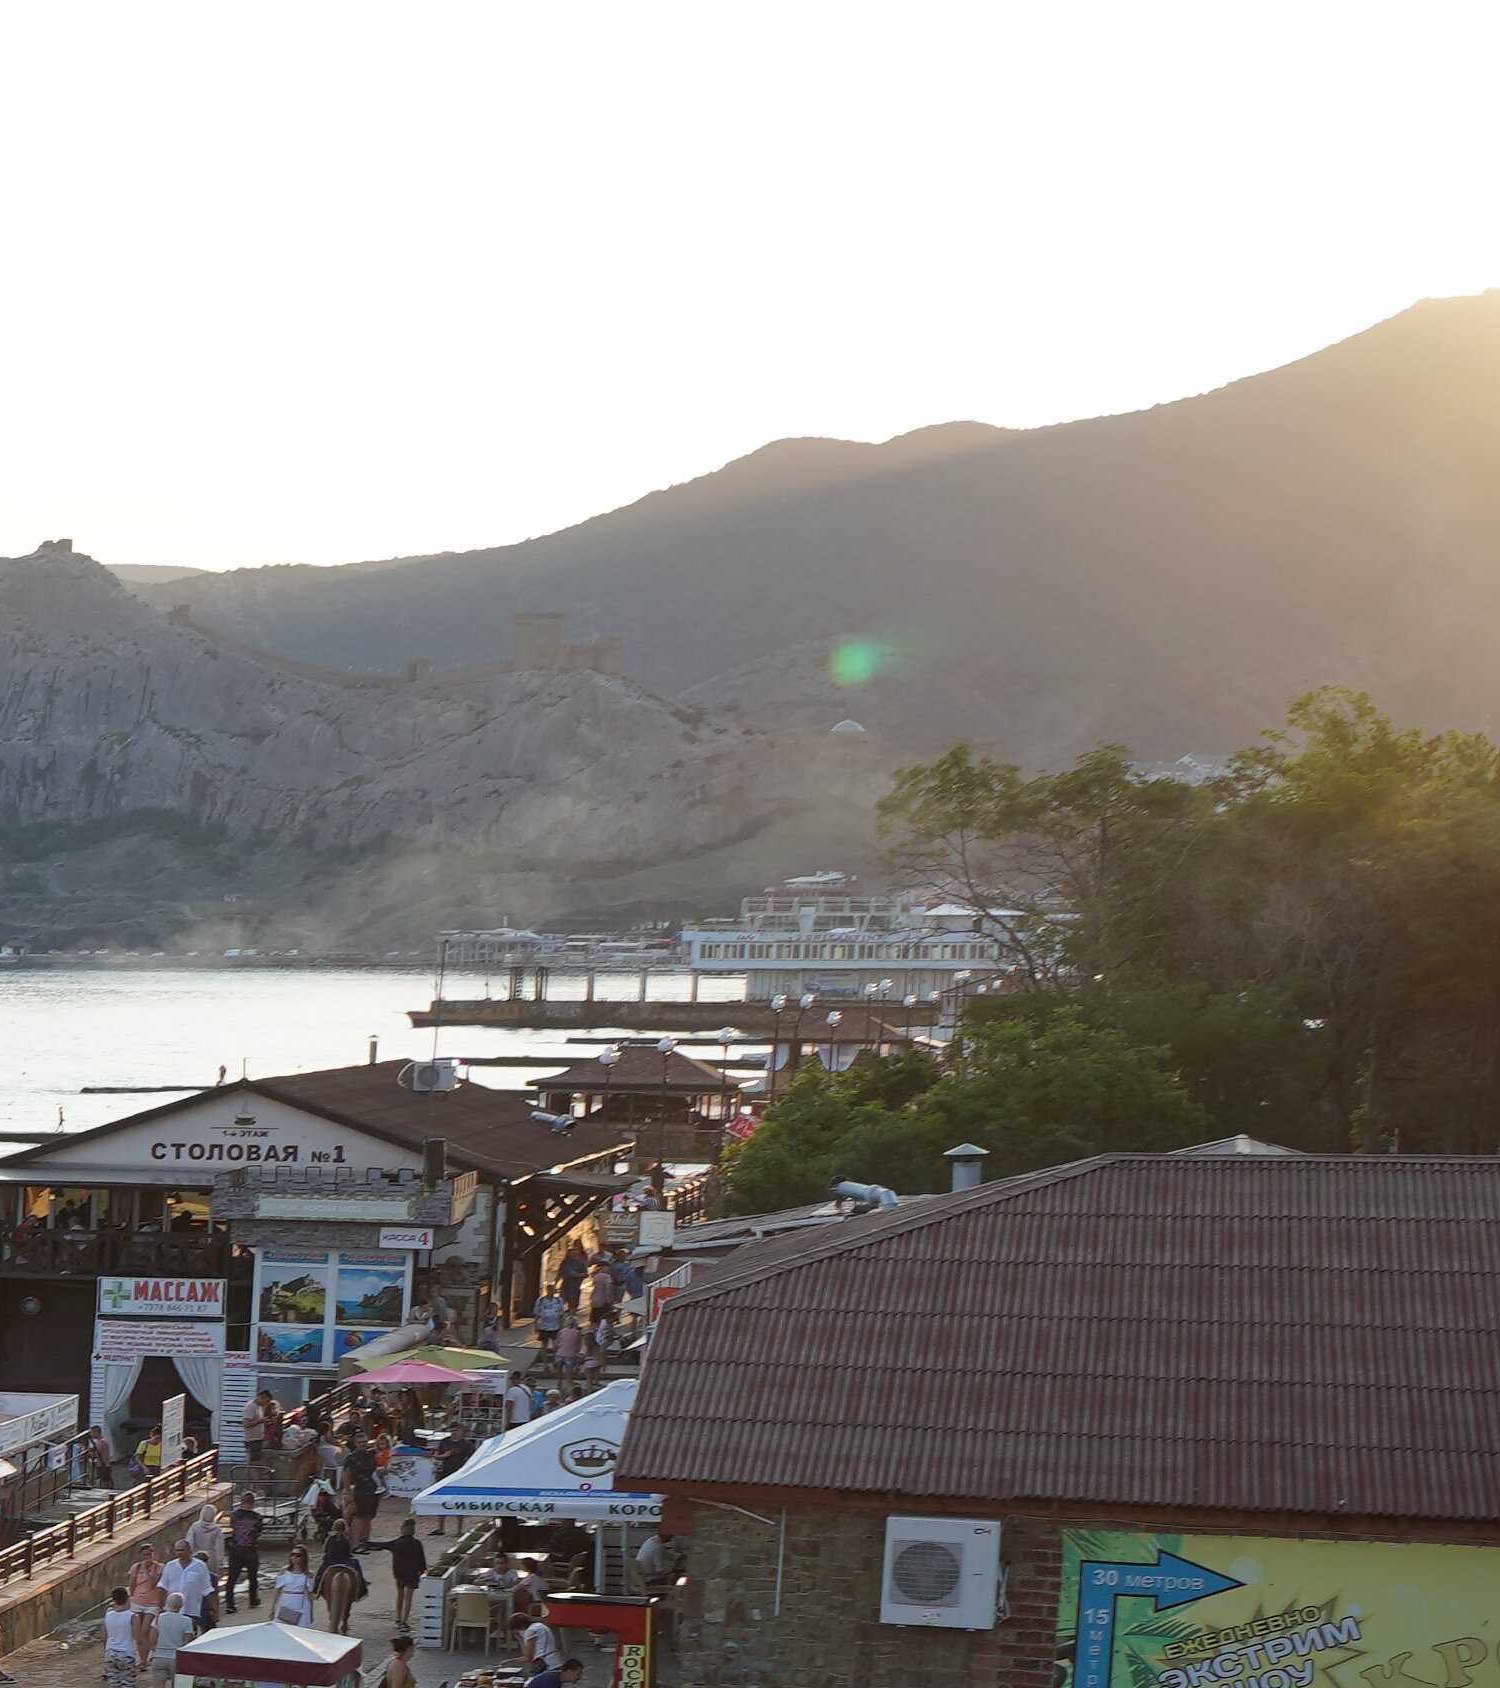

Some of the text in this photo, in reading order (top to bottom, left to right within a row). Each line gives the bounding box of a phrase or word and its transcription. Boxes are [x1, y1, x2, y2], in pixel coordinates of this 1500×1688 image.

[239, 1130, 269, 1138] ЭТАЖ
[150, 1143, 299, 1163] СТОЛОВАЯ
[382, 1232, 429, 1246] КАССА 4
[133, 1280, 221, 1303] МАССАЖ
[441, 1501, 662, 1516] СИБИРСКАЯ КОРО
[1092, 1569, 1204, 1594] 30 метров
[1084, 1607, 1110, 1625] 15
[1163, 1605, 1322, 1661] ЕЖЕДНЕВНО
